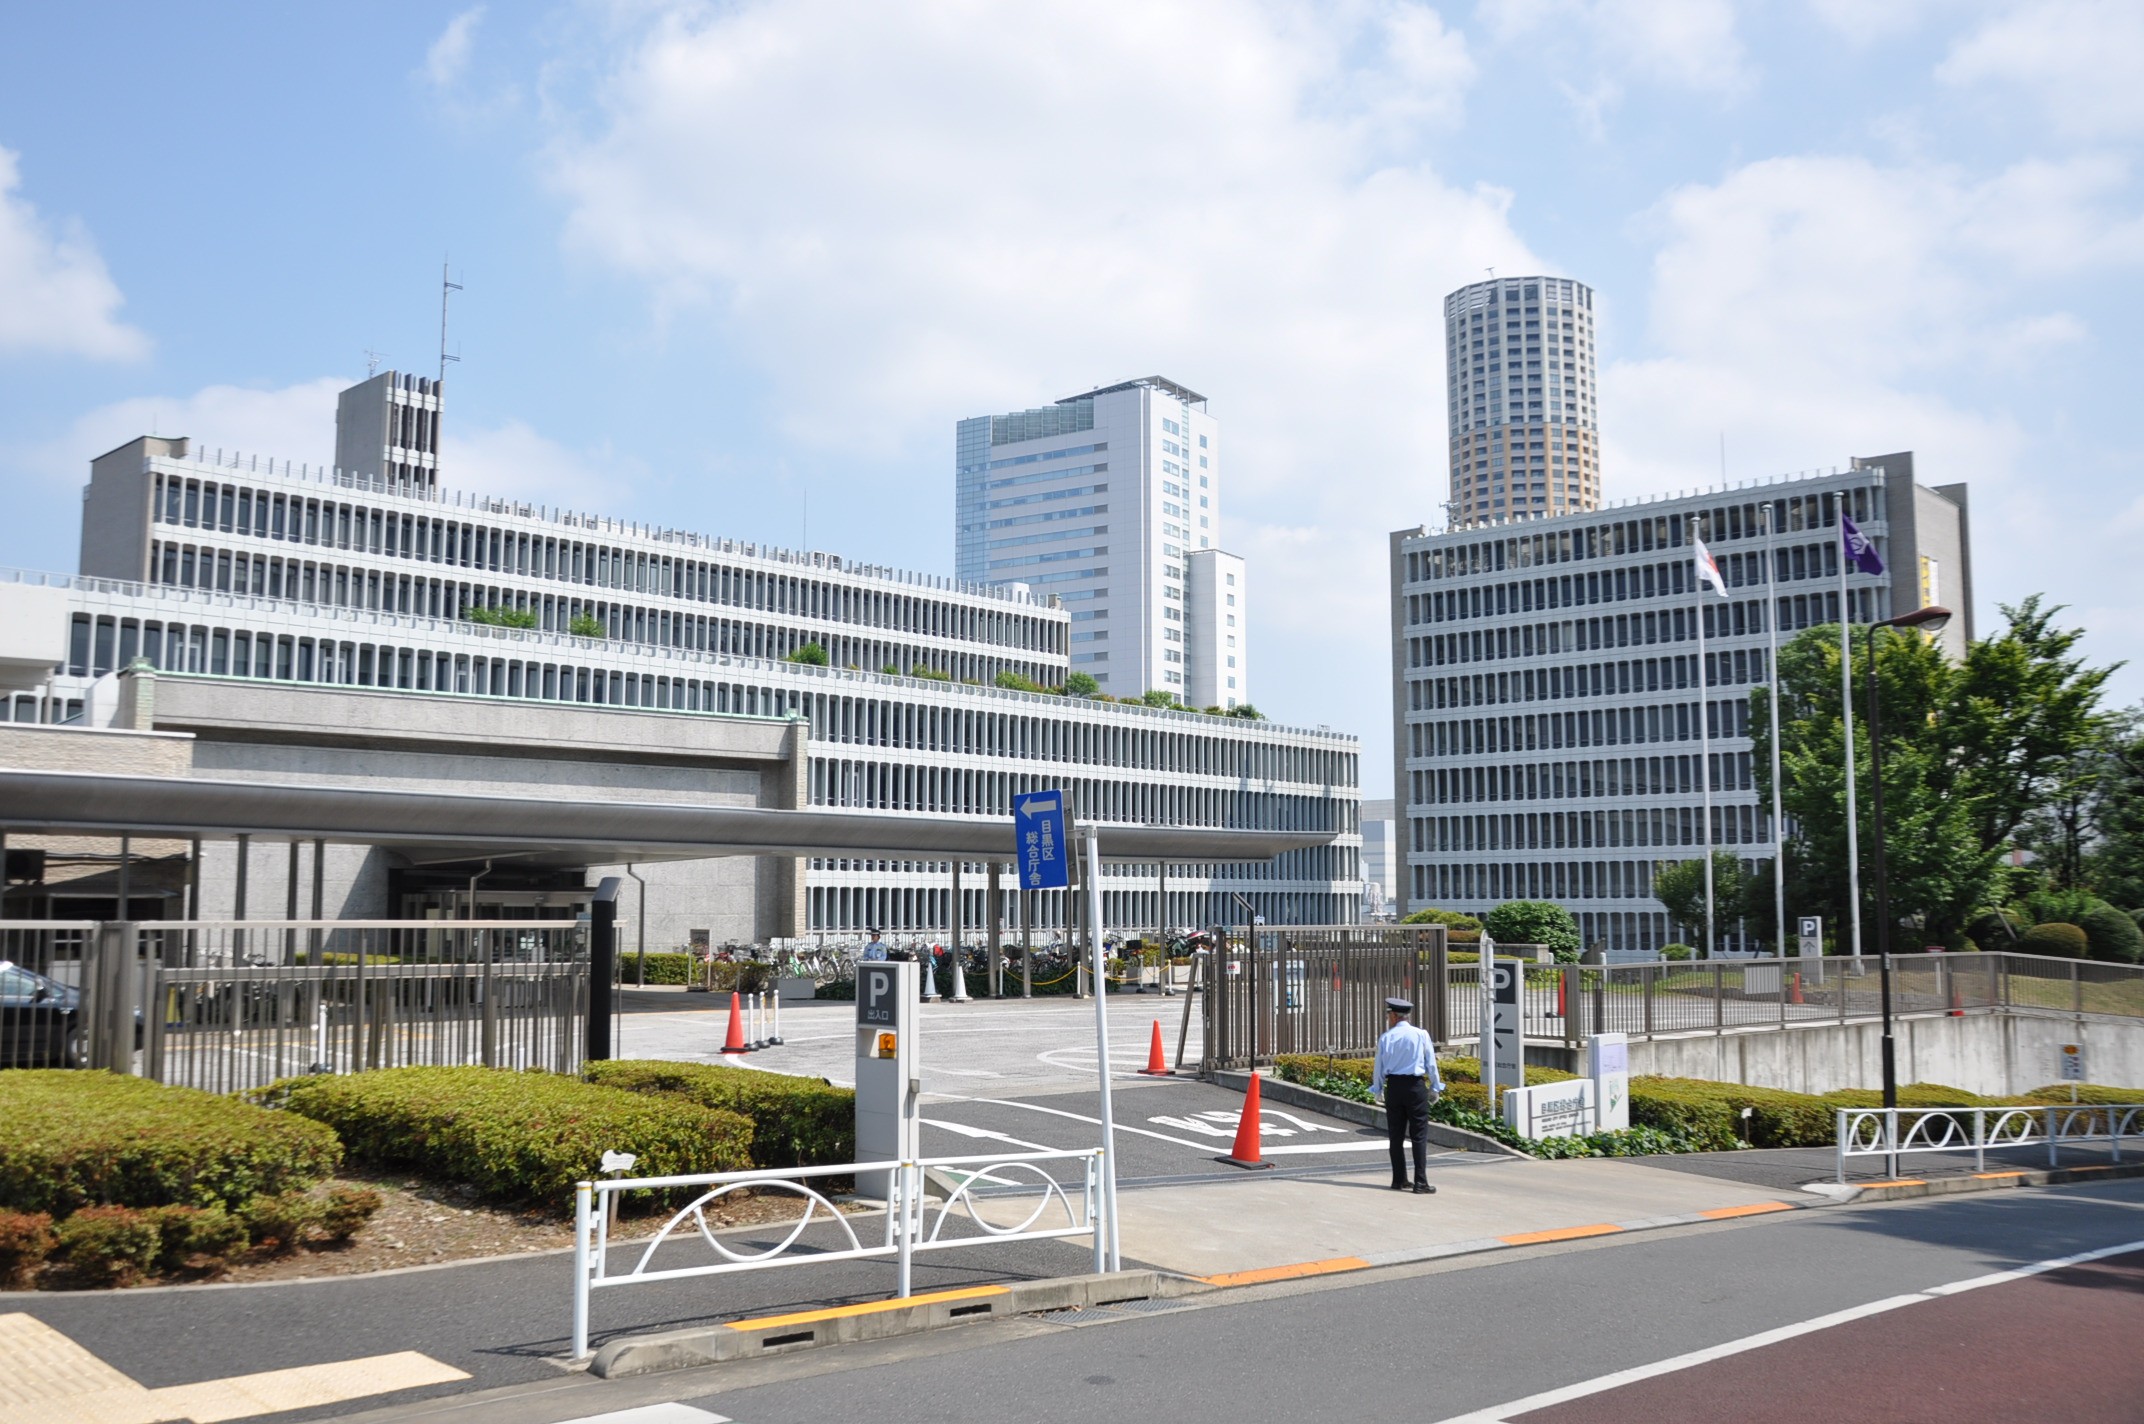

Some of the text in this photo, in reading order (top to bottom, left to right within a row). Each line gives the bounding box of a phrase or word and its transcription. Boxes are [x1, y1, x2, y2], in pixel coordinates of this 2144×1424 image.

[1026, 831, 1041, 886] 総合庁舎
[1041, 820, 1055, 861] 目黒区
[1803, 920, 1815, 936] P
[870, 971, 889, 1007] P
[867, 1009, 889, 1020] 出入口
